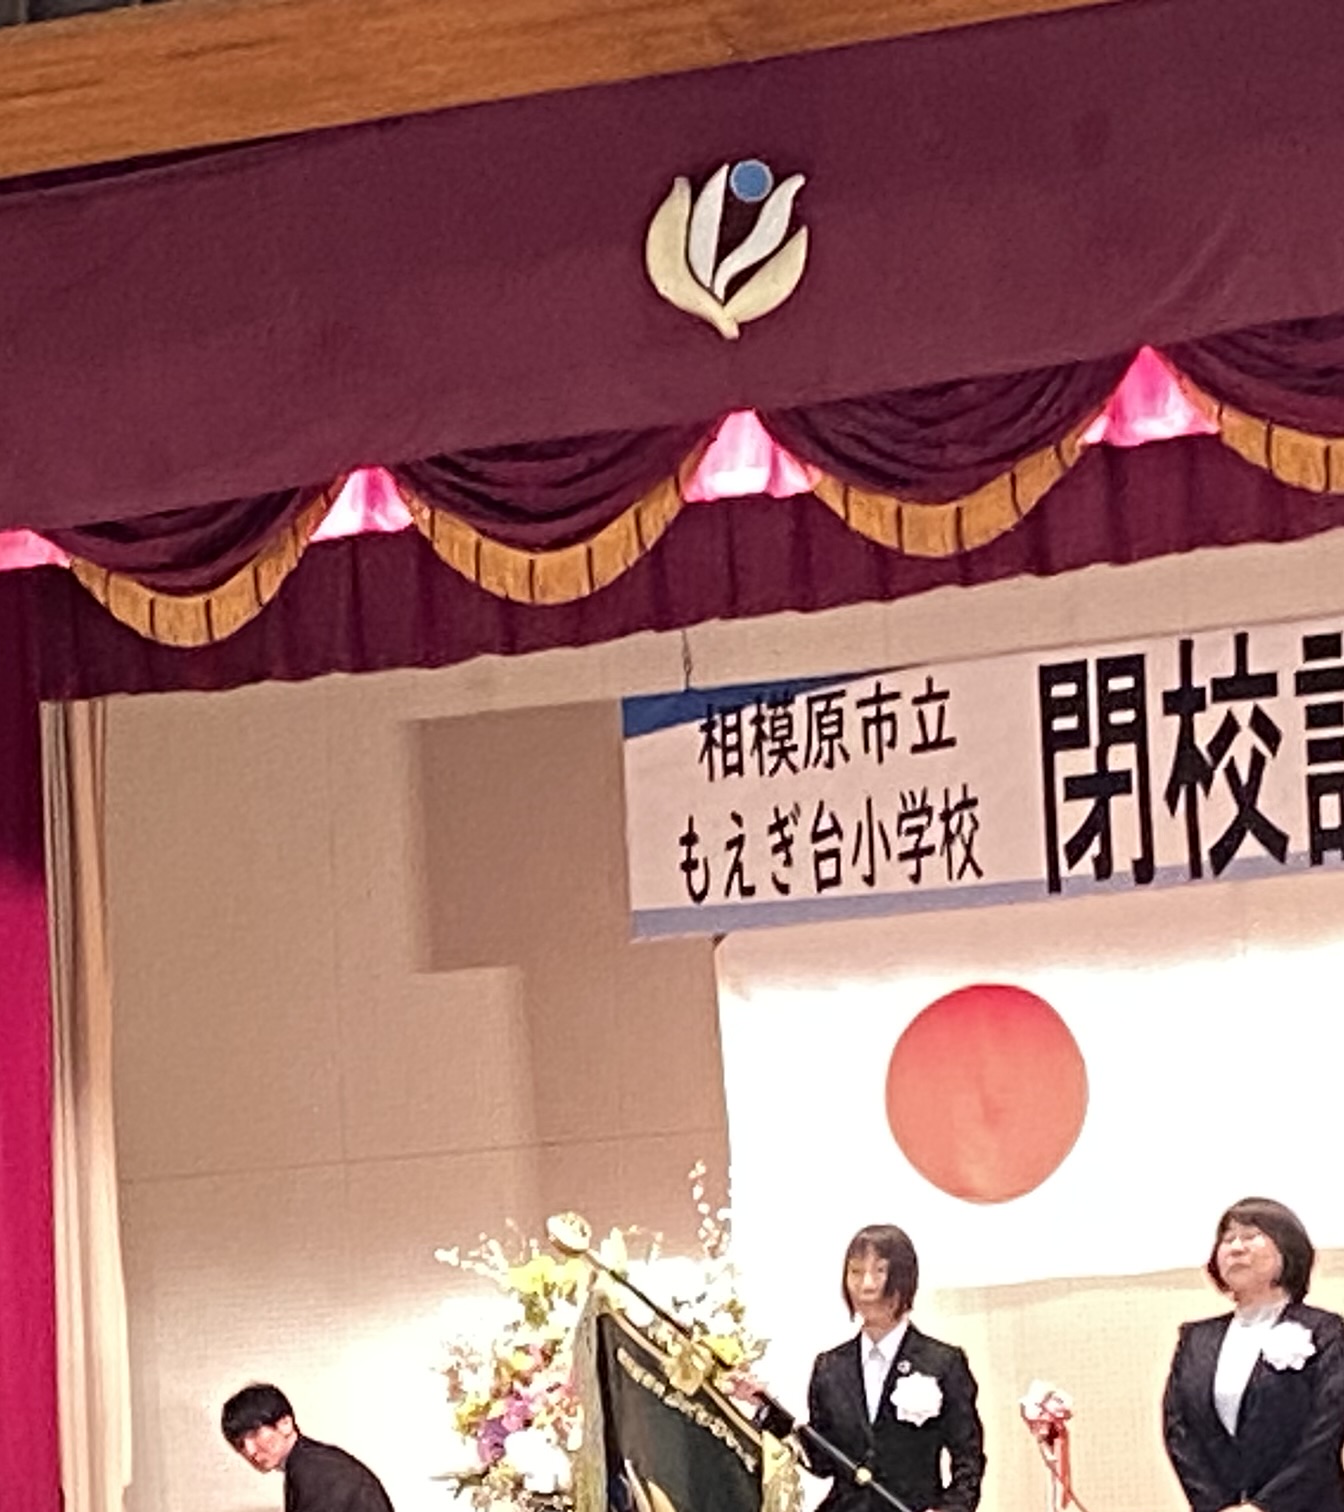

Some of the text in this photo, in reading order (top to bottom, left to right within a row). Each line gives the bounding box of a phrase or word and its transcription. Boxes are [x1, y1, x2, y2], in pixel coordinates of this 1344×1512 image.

[698, 675, 957, 782] 相模原市立
[678, 783, 984, 904] もえぎ台小学校
